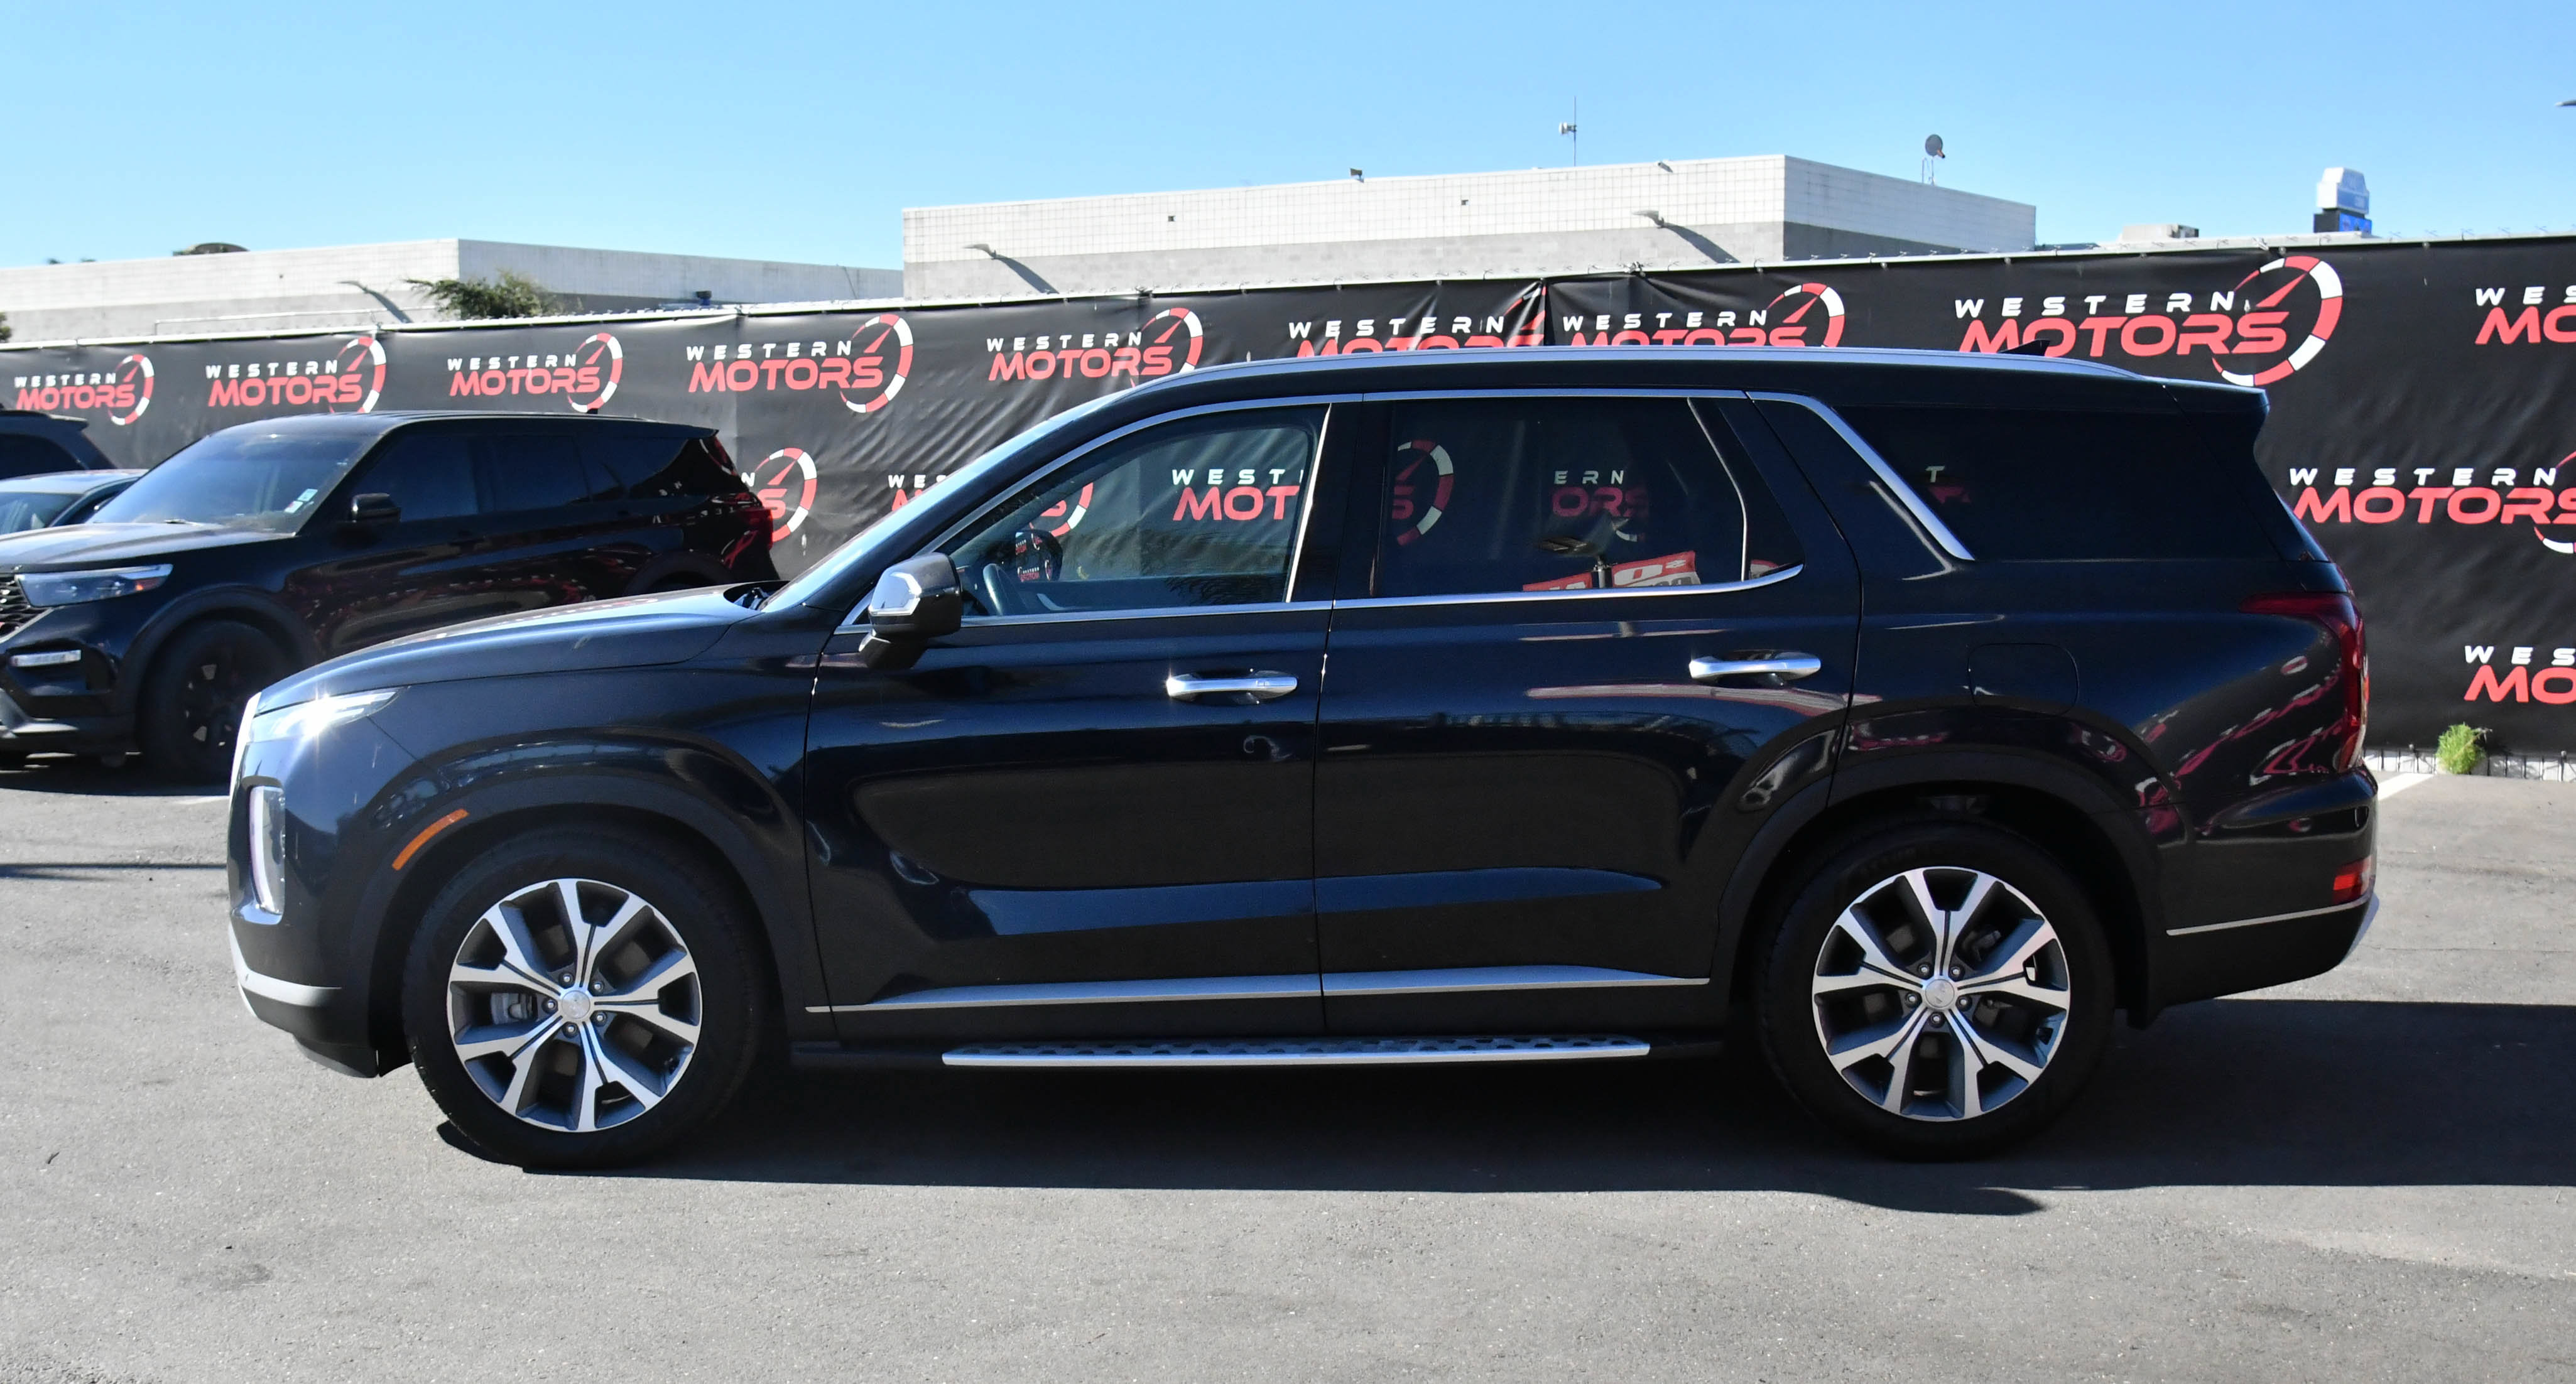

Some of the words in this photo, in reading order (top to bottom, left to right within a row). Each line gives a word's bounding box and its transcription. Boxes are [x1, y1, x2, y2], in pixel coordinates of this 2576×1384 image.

[1955, 291, 2234, 318] WESTERN
[1289, 316, 1504, 339] WESTERN
[1563, 310, 1767, 331] WESTERN
[986, 332, 1142, 352] WESTERN
[1959, 311, 2290, 357] MOTORS
[686, 340, 852, 361] WESTERN
[205, 359, 338, 379] WESTERN
[447, 354, 577, 371] WESTERN
[688, 355, 884, 392] MOTORS
[988, 345, 1173, 381] MOTORS
[14, 372, 116, 388] WESTERN
[208, 374, 362, 408] MOTORS
[450, 366, 601, 396] MOTORS
[16, 384, 136, 410] MOTORS
[1172, 468, 1304, 485] WEST
[2290, 468, 2557, 486] WESTERN
